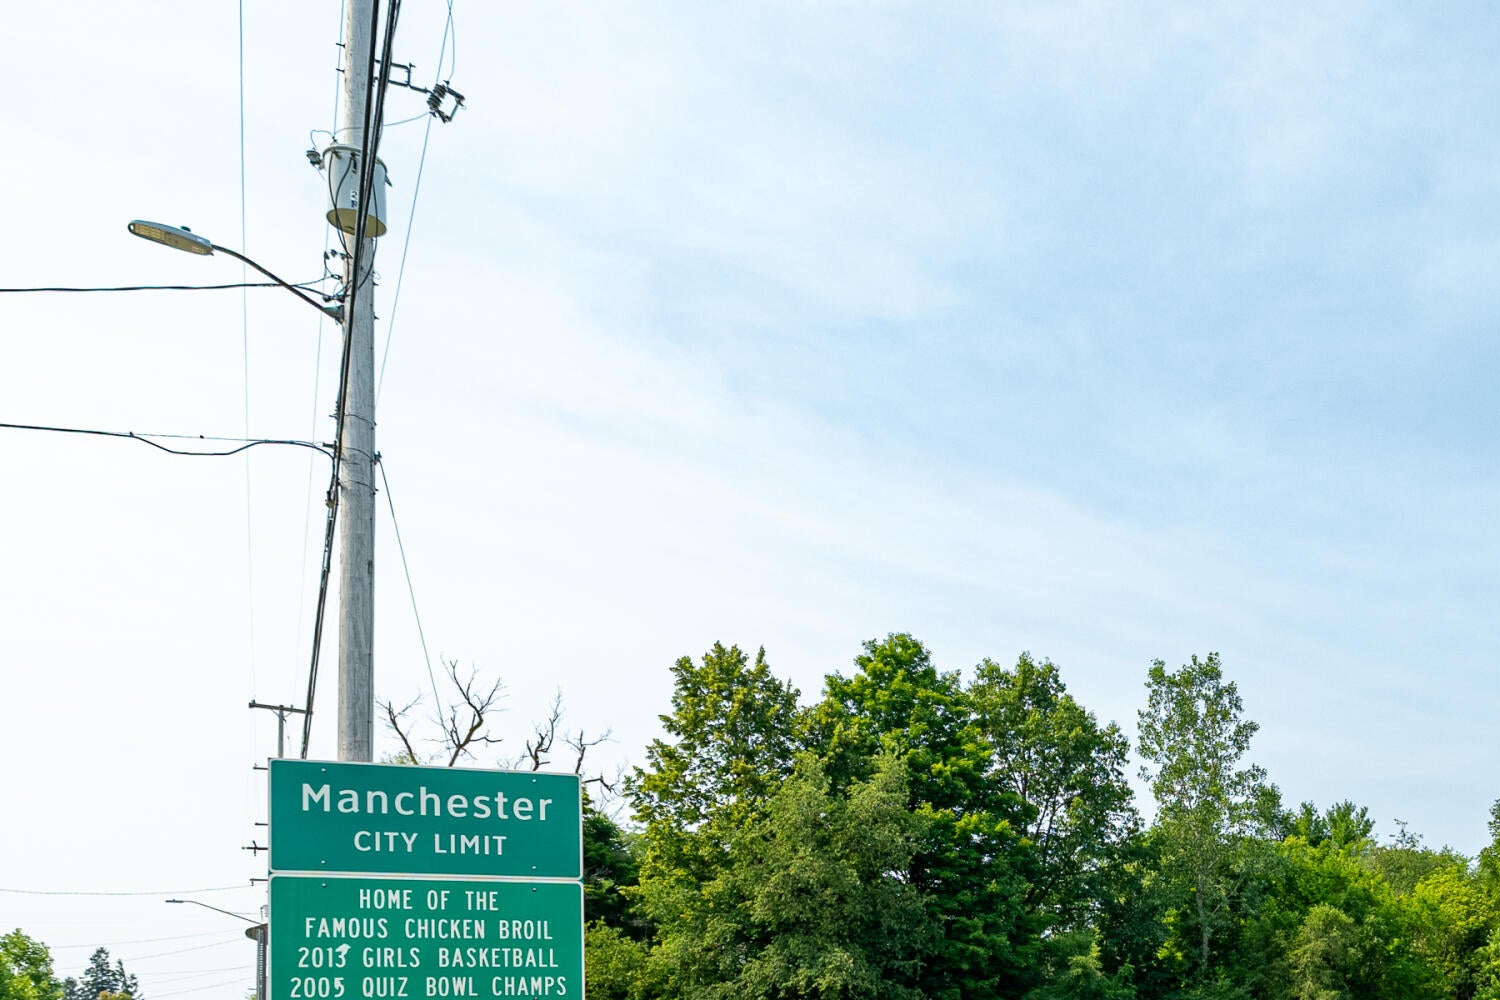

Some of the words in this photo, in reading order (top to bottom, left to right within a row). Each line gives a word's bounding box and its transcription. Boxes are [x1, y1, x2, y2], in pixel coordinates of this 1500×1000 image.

[303, 784, 552, 821] Manchester
[354, 831, 417, 853] CITY
[434, 834, 507, 855] LIMIT
[359, 889, 413, 910] HOME
[427, 890, 450, 910] OF
[465, 891, 499, 911] THE
[305, 918, 388, 938] FAMOUS
[405, 919, 485, 939] CHICKEN
[500, 920, 553, 940] BROIL
[298, 946, 348, 968] 2013
[363, 948, 420, 968] GIRLS
[439, 948, 559, 968] BASKETBALL
[290, 977, 345, 998] 2005
[362, 977, 408, 998] QUIZ
[426, 977, 478, 997] BOWL
[492, 976, 567, 996] CHAMPS
